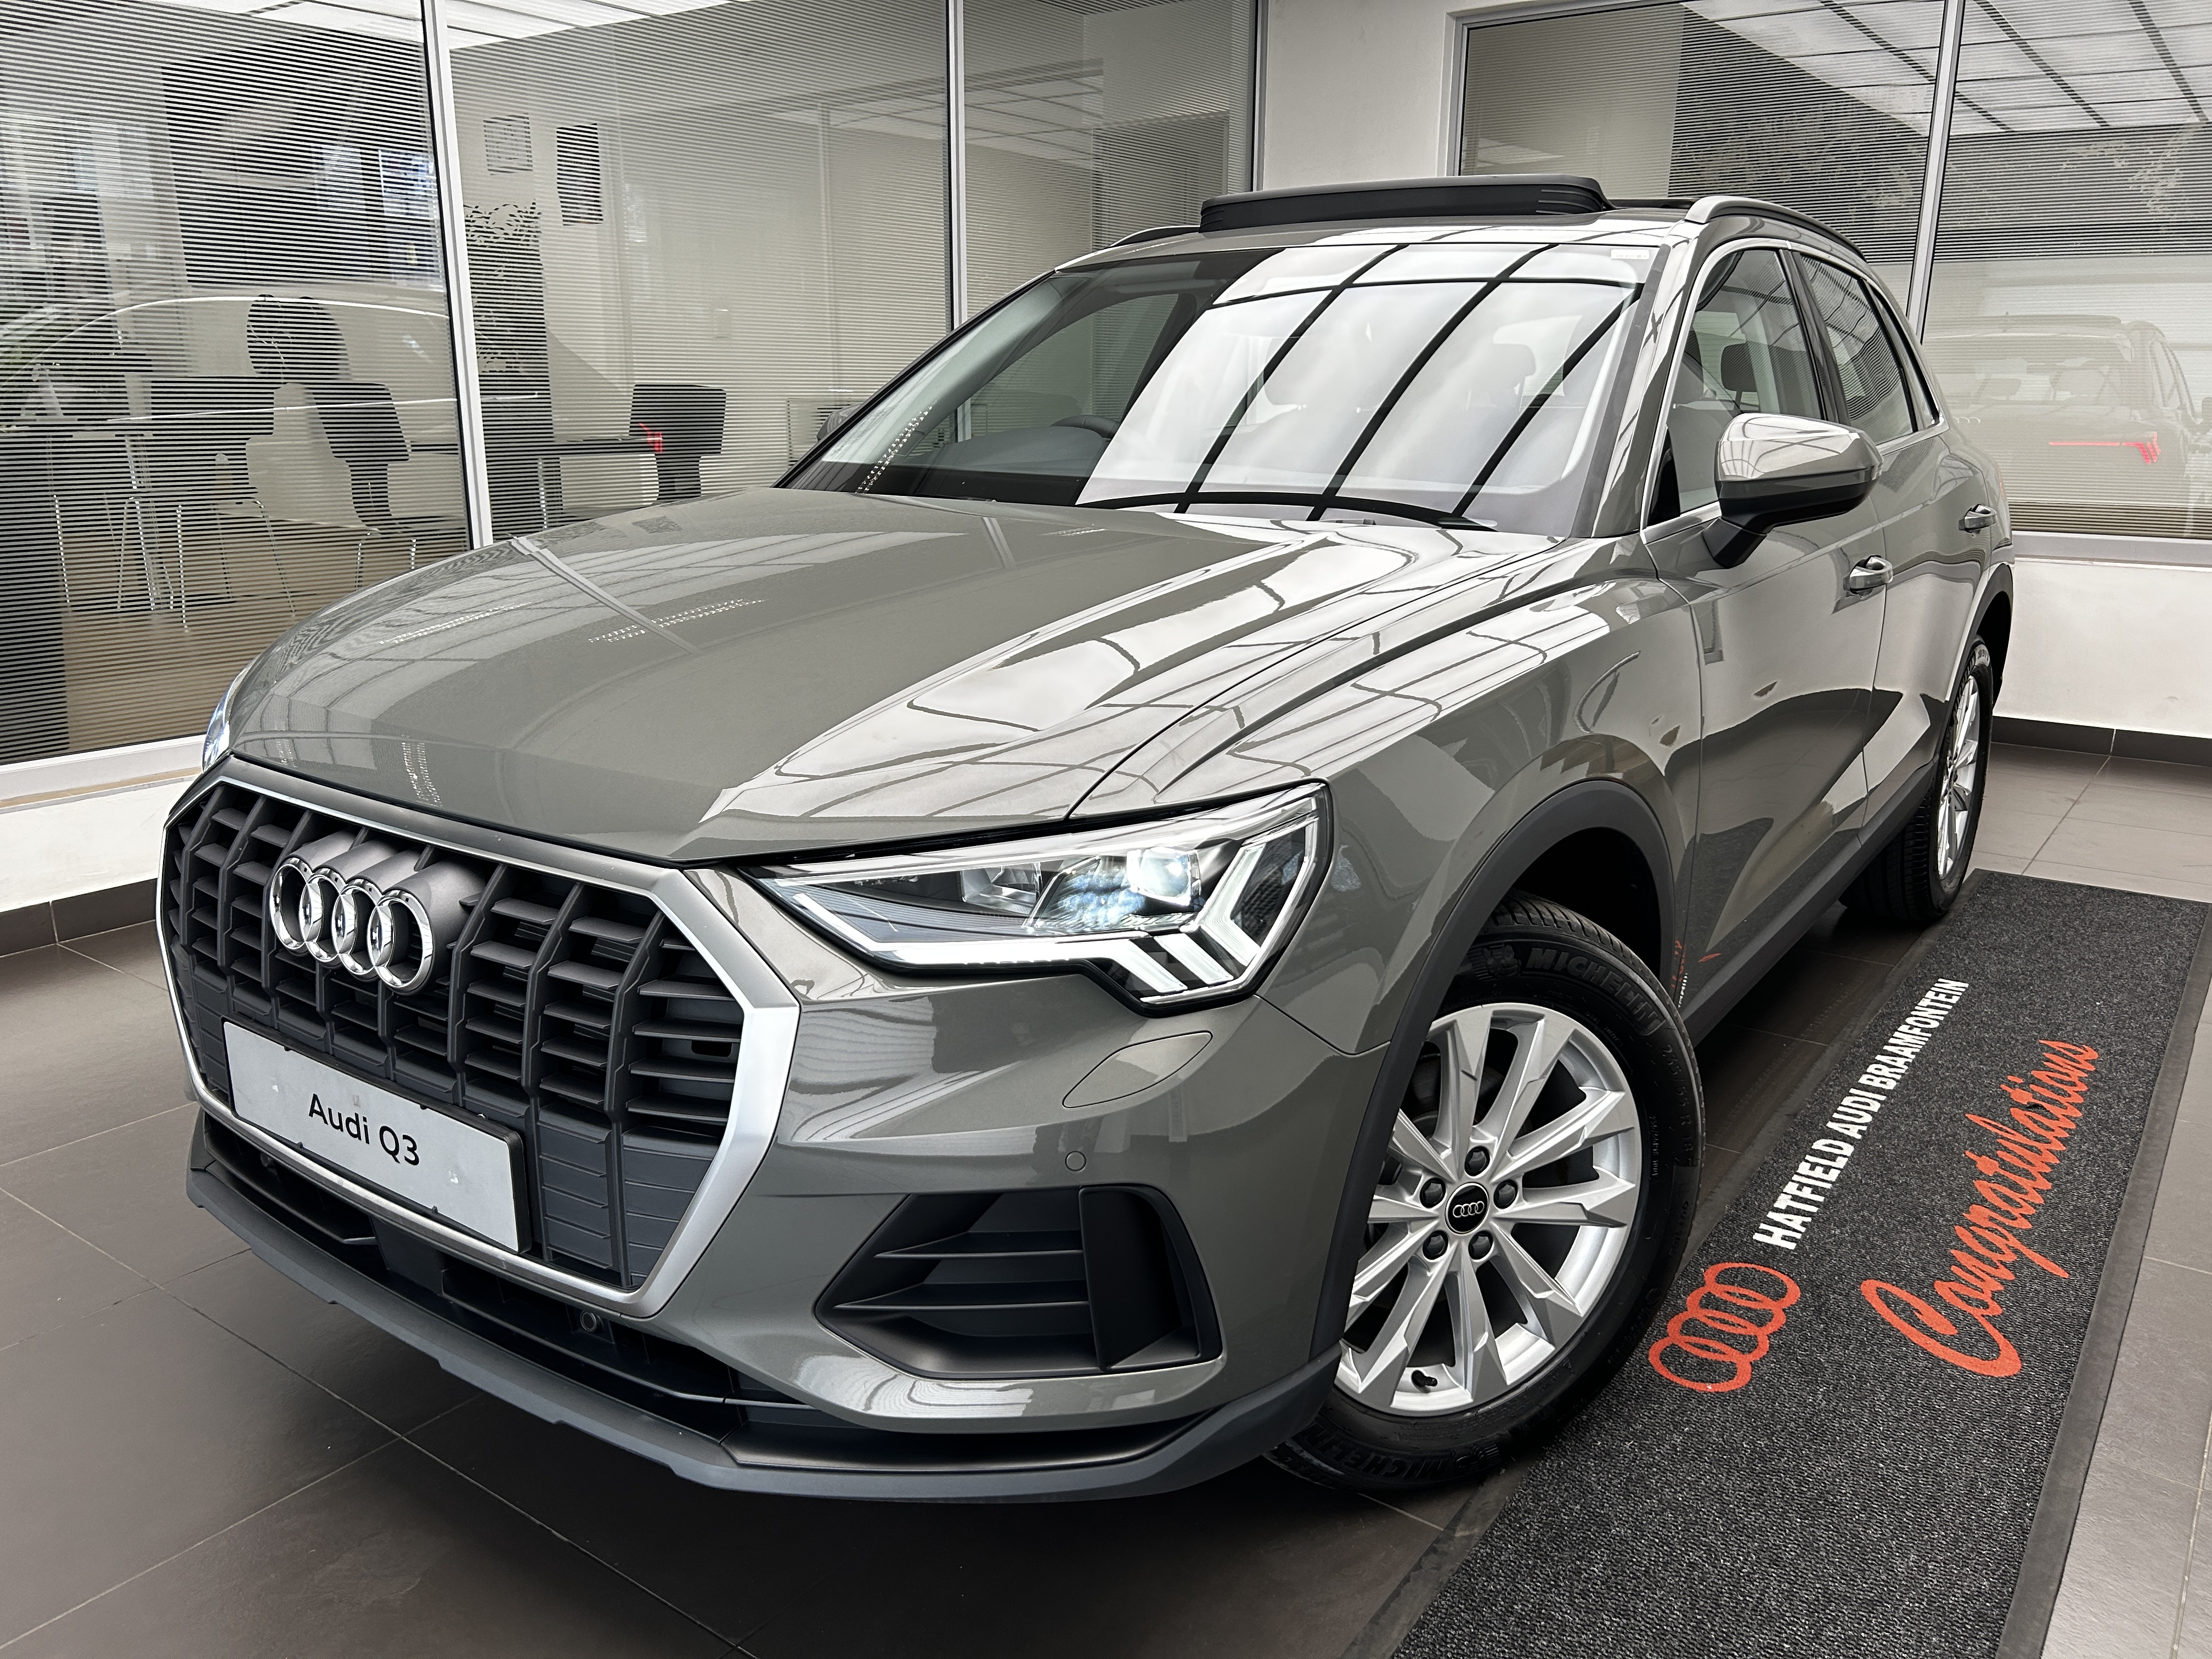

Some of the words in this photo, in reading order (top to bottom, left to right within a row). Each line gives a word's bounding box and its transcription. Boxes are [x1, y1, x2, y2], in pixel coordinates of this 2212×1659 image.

[1526, 947, 1662, 1031] MICHELIN
[308, 1093, 370, 1145] Audi
[379, 1125, 420, 1166] Q3
[1752, 1138, 1854, 1250] HATFIELD
[1826, 1088, 1887, 1139] AUDI
[1858, 978, 1969, 1090] BRAAMFONTEIN
[1860, 1040, 2099, 1377] Congratulations
[1300, 1422, 1445, 1479] MICHELIN
